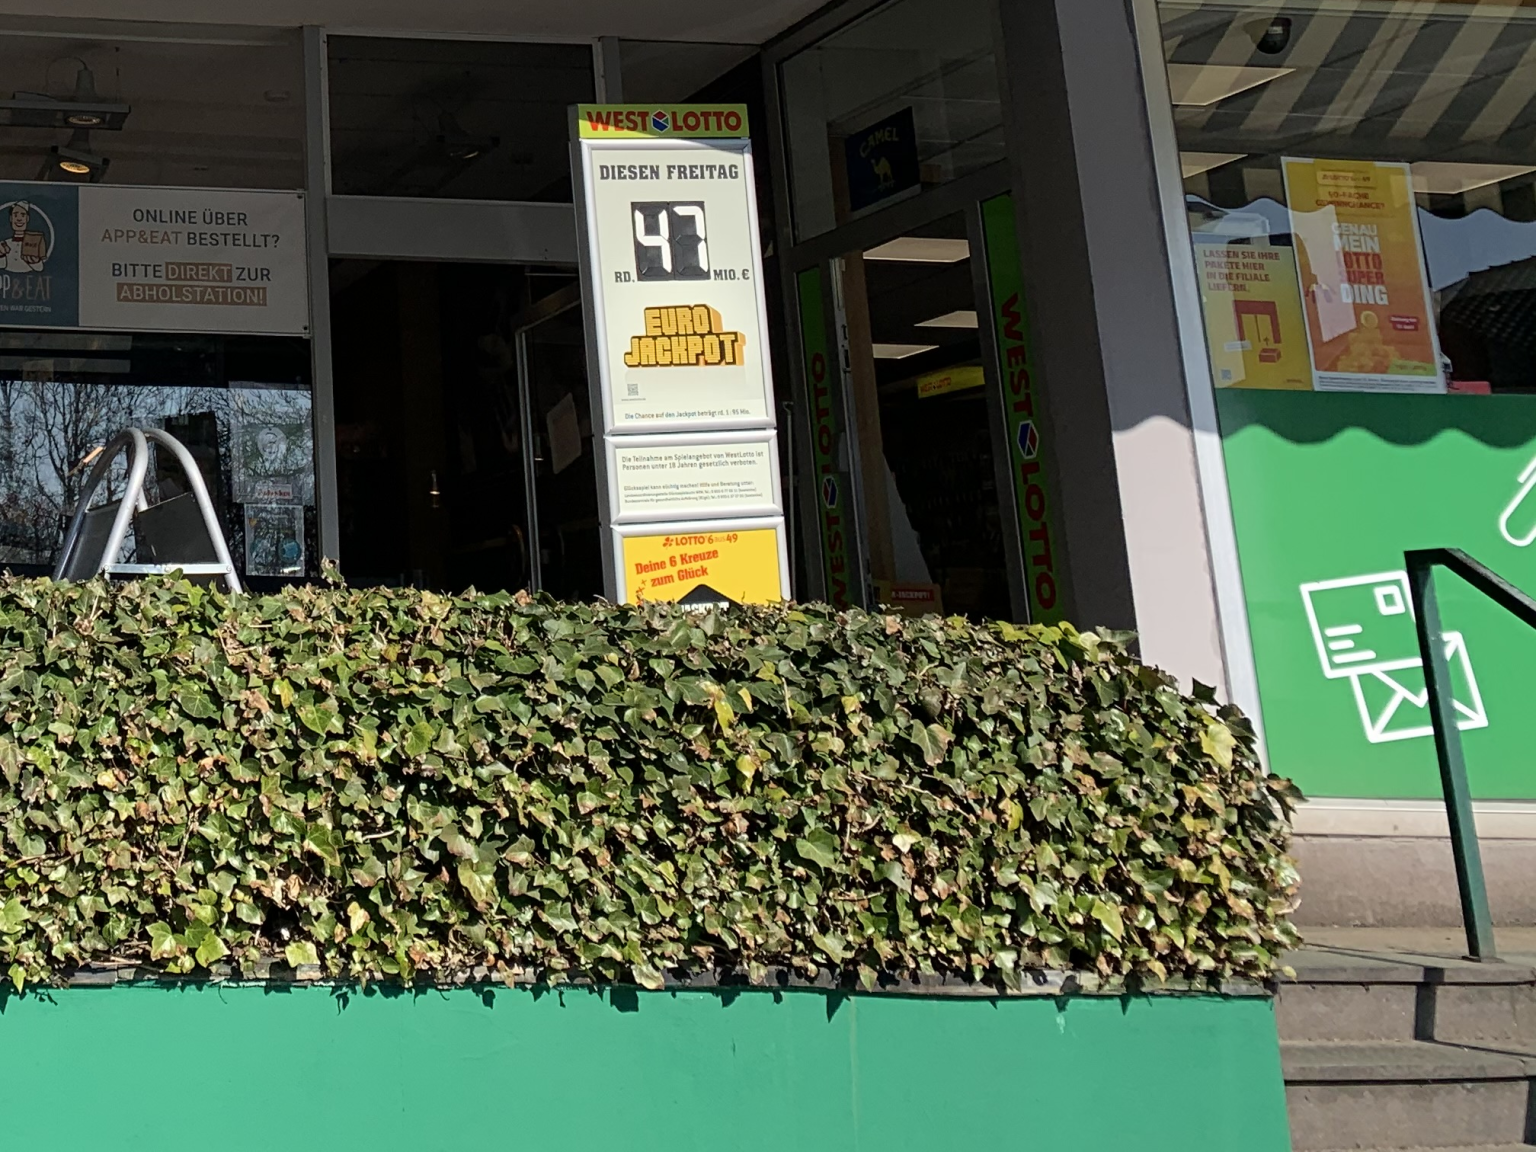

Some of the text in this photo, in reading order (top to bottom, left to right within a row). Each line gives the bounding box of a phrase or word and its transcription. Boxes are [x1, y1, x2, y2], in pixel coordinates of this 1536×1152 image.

[859, 126, 900, 158] CAMEL
[599, 163, 739, 181] DIESEN FREITAG
[132, 208, 248, 226] ONLINE ÜBER
[100, 228, 280, 248] APP&EAT BESTELLT?
[1331, 222, 1378, 236] GENAU
[614, 270, 635, 283] RD.
[634, 204, 709, 274] 47
[713, 269, 740, 281] MIO.
[1332, 235, 1381, 252] MEIN
[1203, 249, 1280, 261] LASSEN SIE IHRE
[111, 262, 272, 282] BITTE DIREKT ZUR
[1204, 260, 1265, 271] PAKETE HIER
[1206, 271, 1270, 282] IN DIE FILIALE
[1338, 268, 1385, 285] SUPER
[119, 284, 264, 304] ABHOLSTATION!
[1340, 282, 1390, 306] DING
[644, 304, 715, 336] EURO
[624, 332, 741, 367] JACKPOT
[624, 412, 634, 420] Die
[634, 412, 655, 420] Chance
[655, 411, 664, 419] auf
[676, 410, 697, 419] Jackpot
[697, 409, 717, 418] beträgt
[621, 455, 632, 463] Die
[632, 454, 663, 462] Teilnahme
[674, 452, 713, 462] Spielangebot
[724, 451, 755, 459] WestLotto
[622, 463, 651, 471] Personen
[668, 461, 676, 469] 18
[677, 461, 698, 469] Jahren
[698, 459, 730, 470] gesetzlich
[730, 459, 758, 467] verboten.
[675, 535, 705, 546] LOTTO
[634, 549, 719, 575] Deine 6 Kreuze
[650, 564, 709, 588] zum Glück
